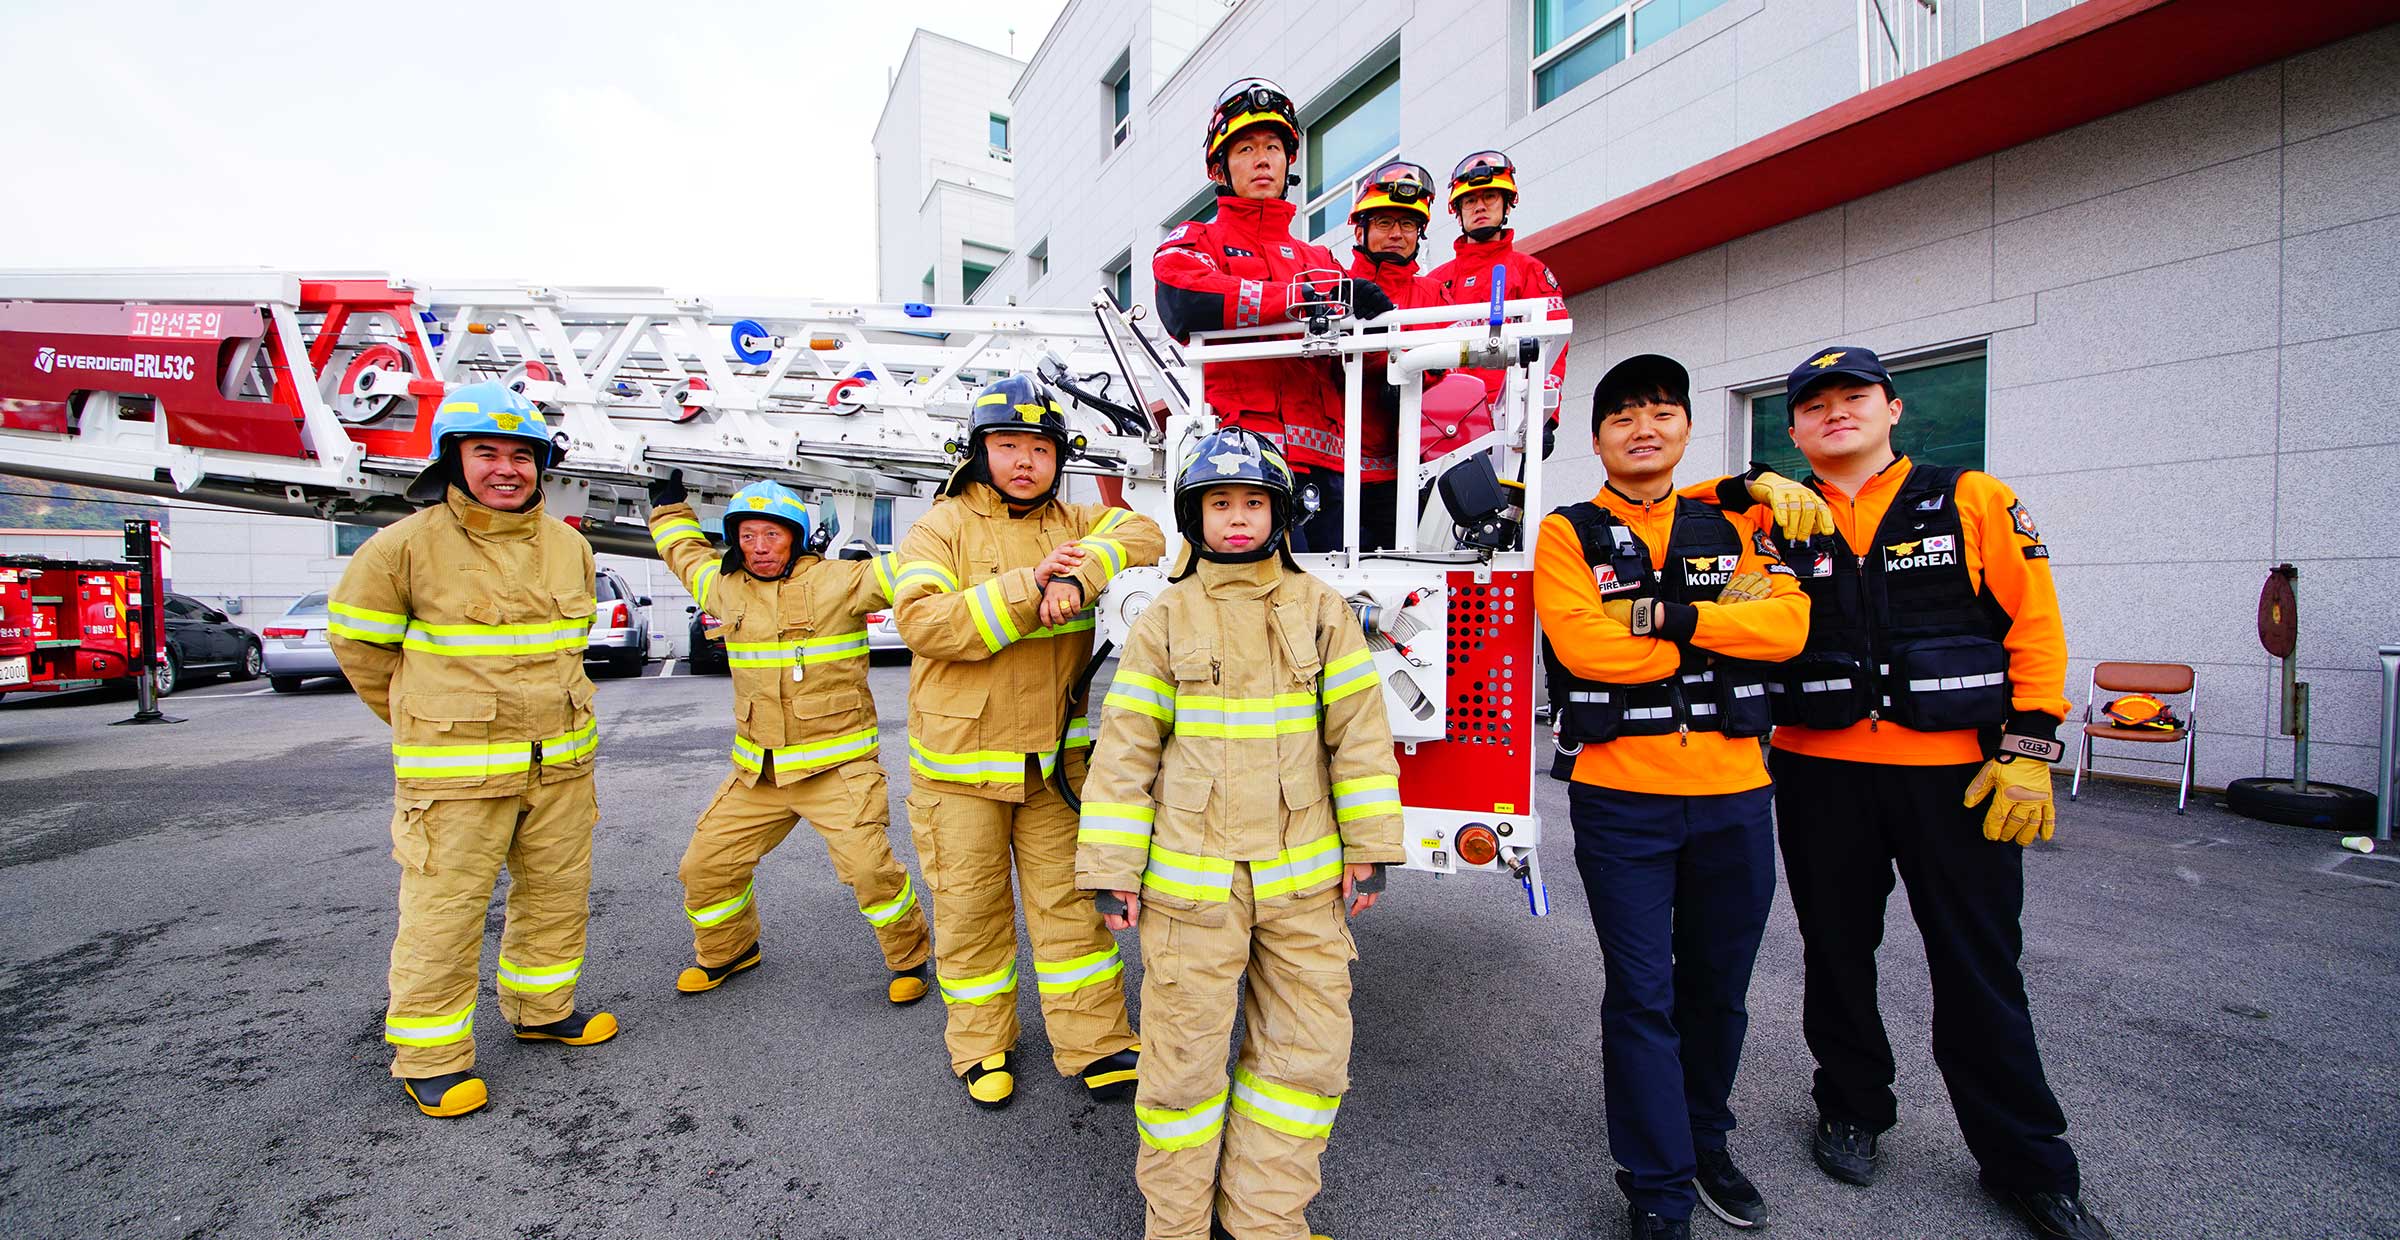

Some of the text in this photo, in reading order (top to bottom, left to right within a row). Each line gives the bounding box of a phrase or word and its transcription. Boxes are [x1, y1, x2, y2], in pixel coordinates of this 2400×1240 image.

[132, 311, 222, 338] 고압선주의
[134, 353, 195, 381] ERL53C
[1887, 552, 1955, 572] KOREA
[1599, 581, 1619, 592] FIRE
[0, 628, 20, 638] 원소방
[2022, 740, 2050, 754] PETZL
